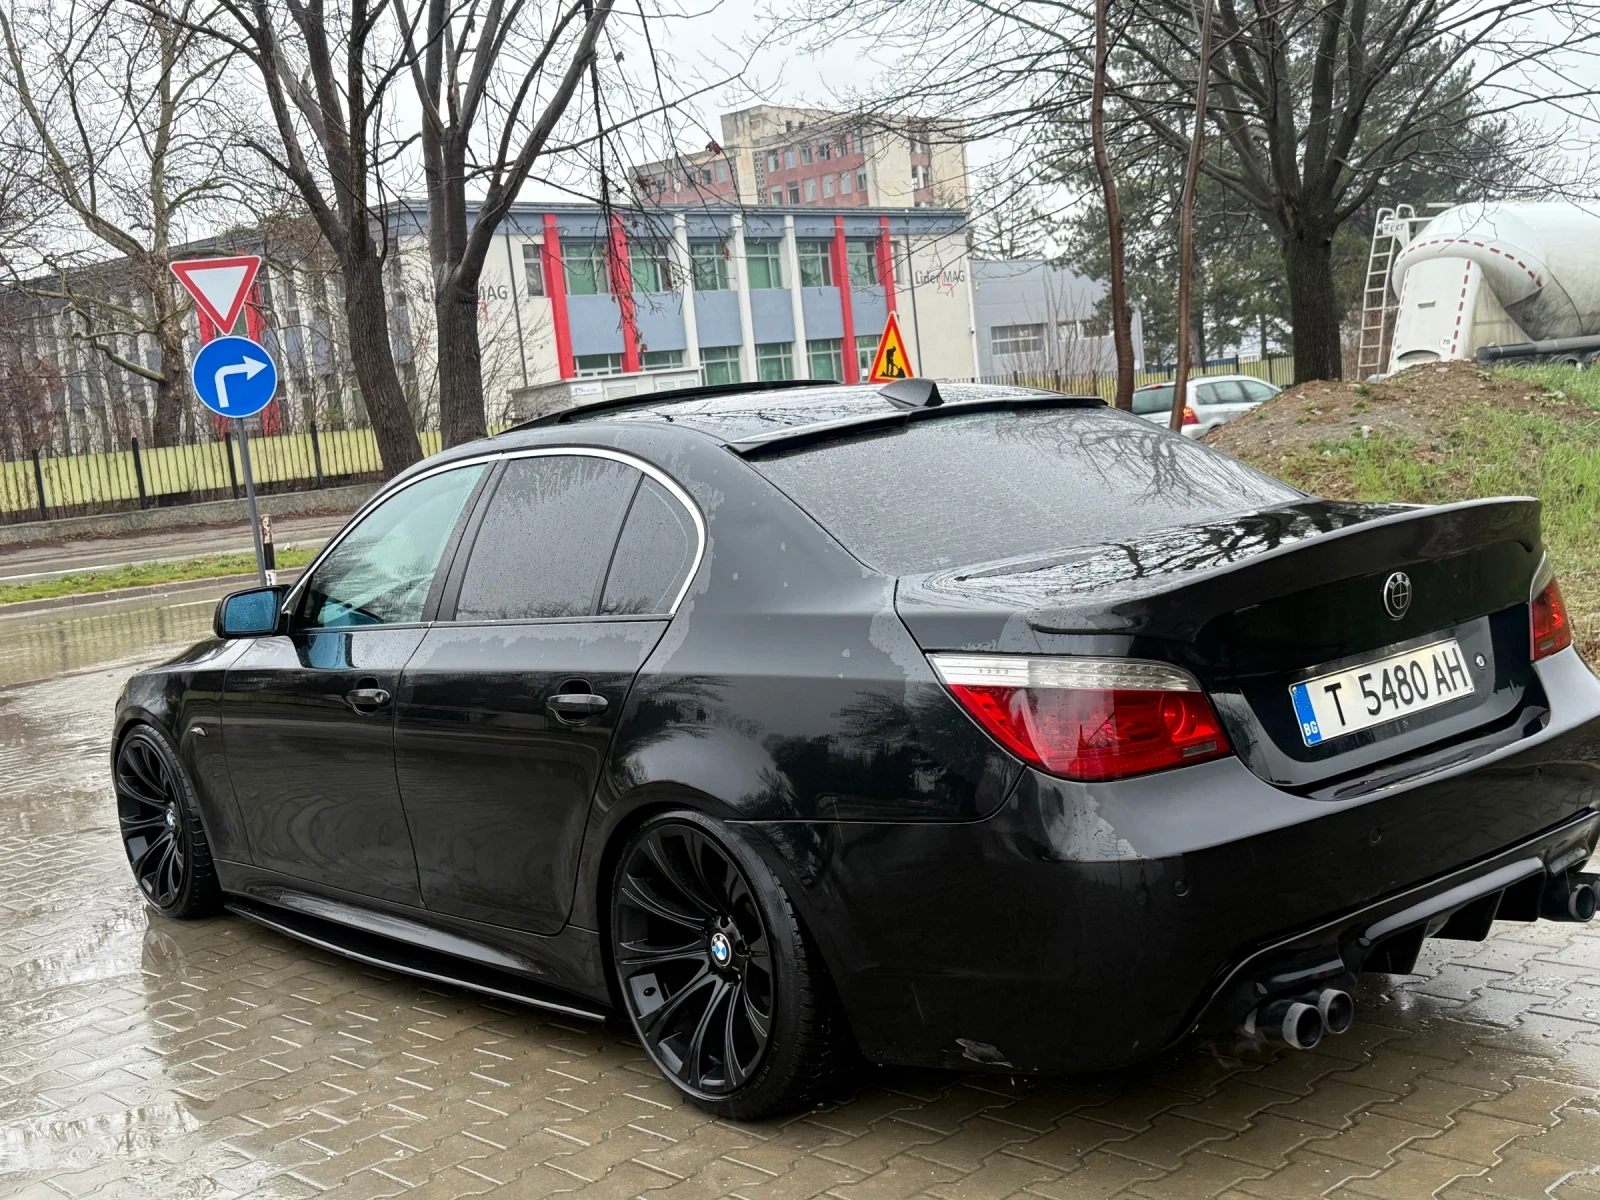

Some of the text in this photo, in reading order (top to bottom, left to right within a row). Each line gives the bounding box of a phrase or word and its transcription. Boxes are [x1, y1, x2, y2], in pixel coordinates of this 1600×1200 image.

[943, 270, 965, 282] MAG
[1324, 647, 1468, 726] T 5480 AH
[1303, 721, 1319, 736] BG
